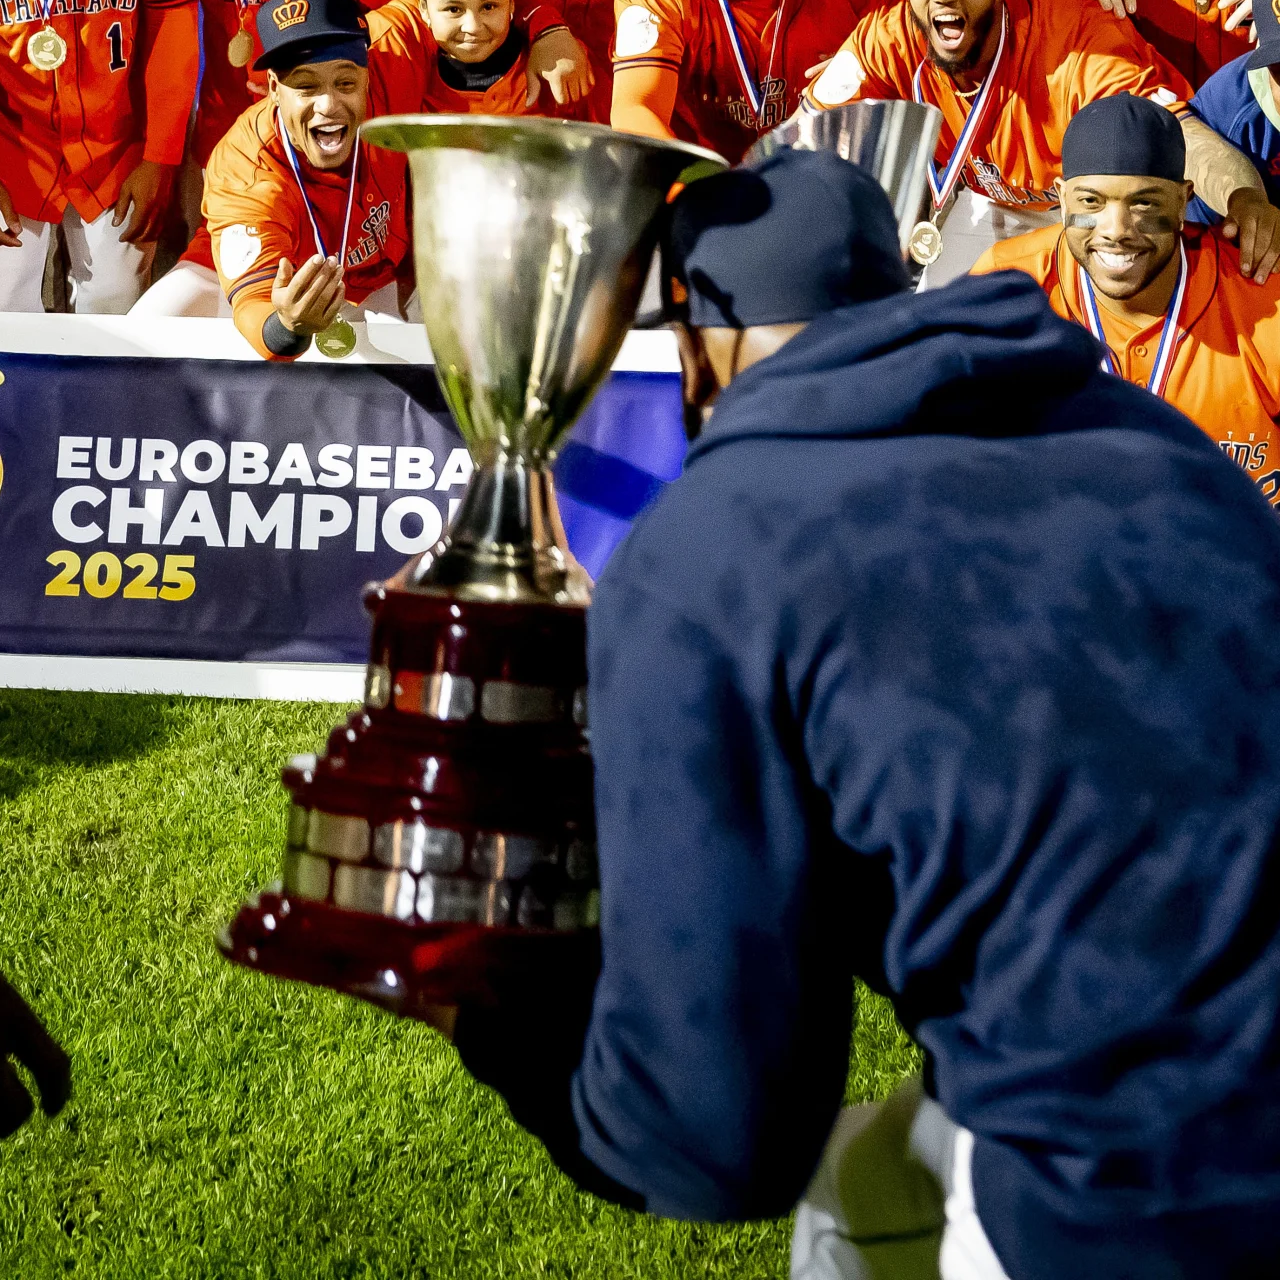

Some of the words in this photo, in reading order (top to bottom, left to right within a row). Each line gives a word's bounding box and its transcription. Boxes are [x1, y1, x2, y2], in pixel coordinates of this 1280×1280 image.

[55, 435, 475, 492] EUROBASEBA
[51, 485, 462, 555] CHAMPIO
[44, 549, 197, 602] 2025
